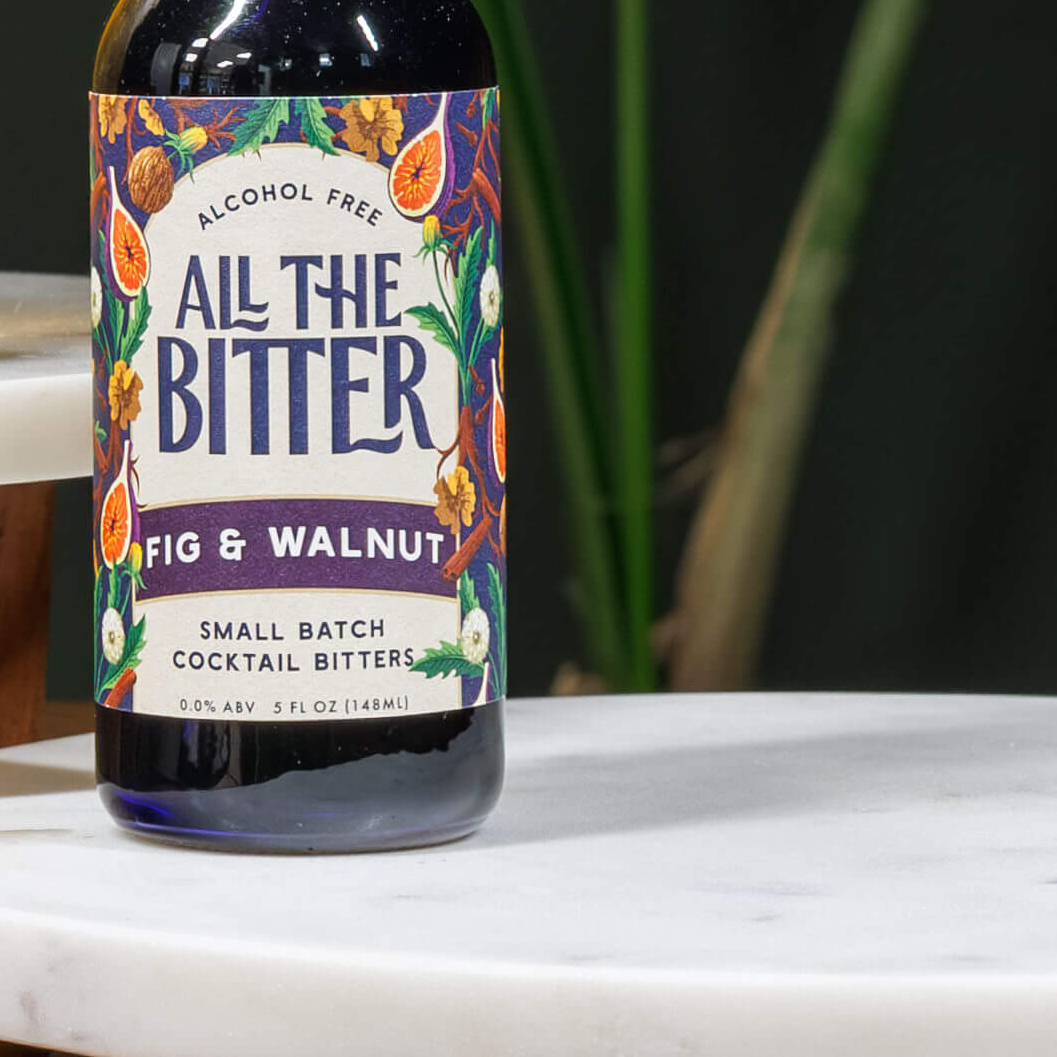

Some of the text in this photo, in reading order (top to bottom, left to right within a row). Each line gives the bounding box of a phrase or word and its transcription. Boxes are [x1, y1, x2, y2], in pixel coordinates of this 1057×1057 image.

[198, 183, 383, 230] ALCOHOL FREE
[176, 253, 402, 332] ALL THE
[157, 335, 436, 455] BITTER
[146, 526, 445, 569] FIG & WALNUT
[199, 619, 385, 641] SMALL BATCH
[172, 648, 415, 672] COCKTAIL BITTERS
[179, 695, 409, 715] 0.0% ABV 5 FL OZ (148ML)
